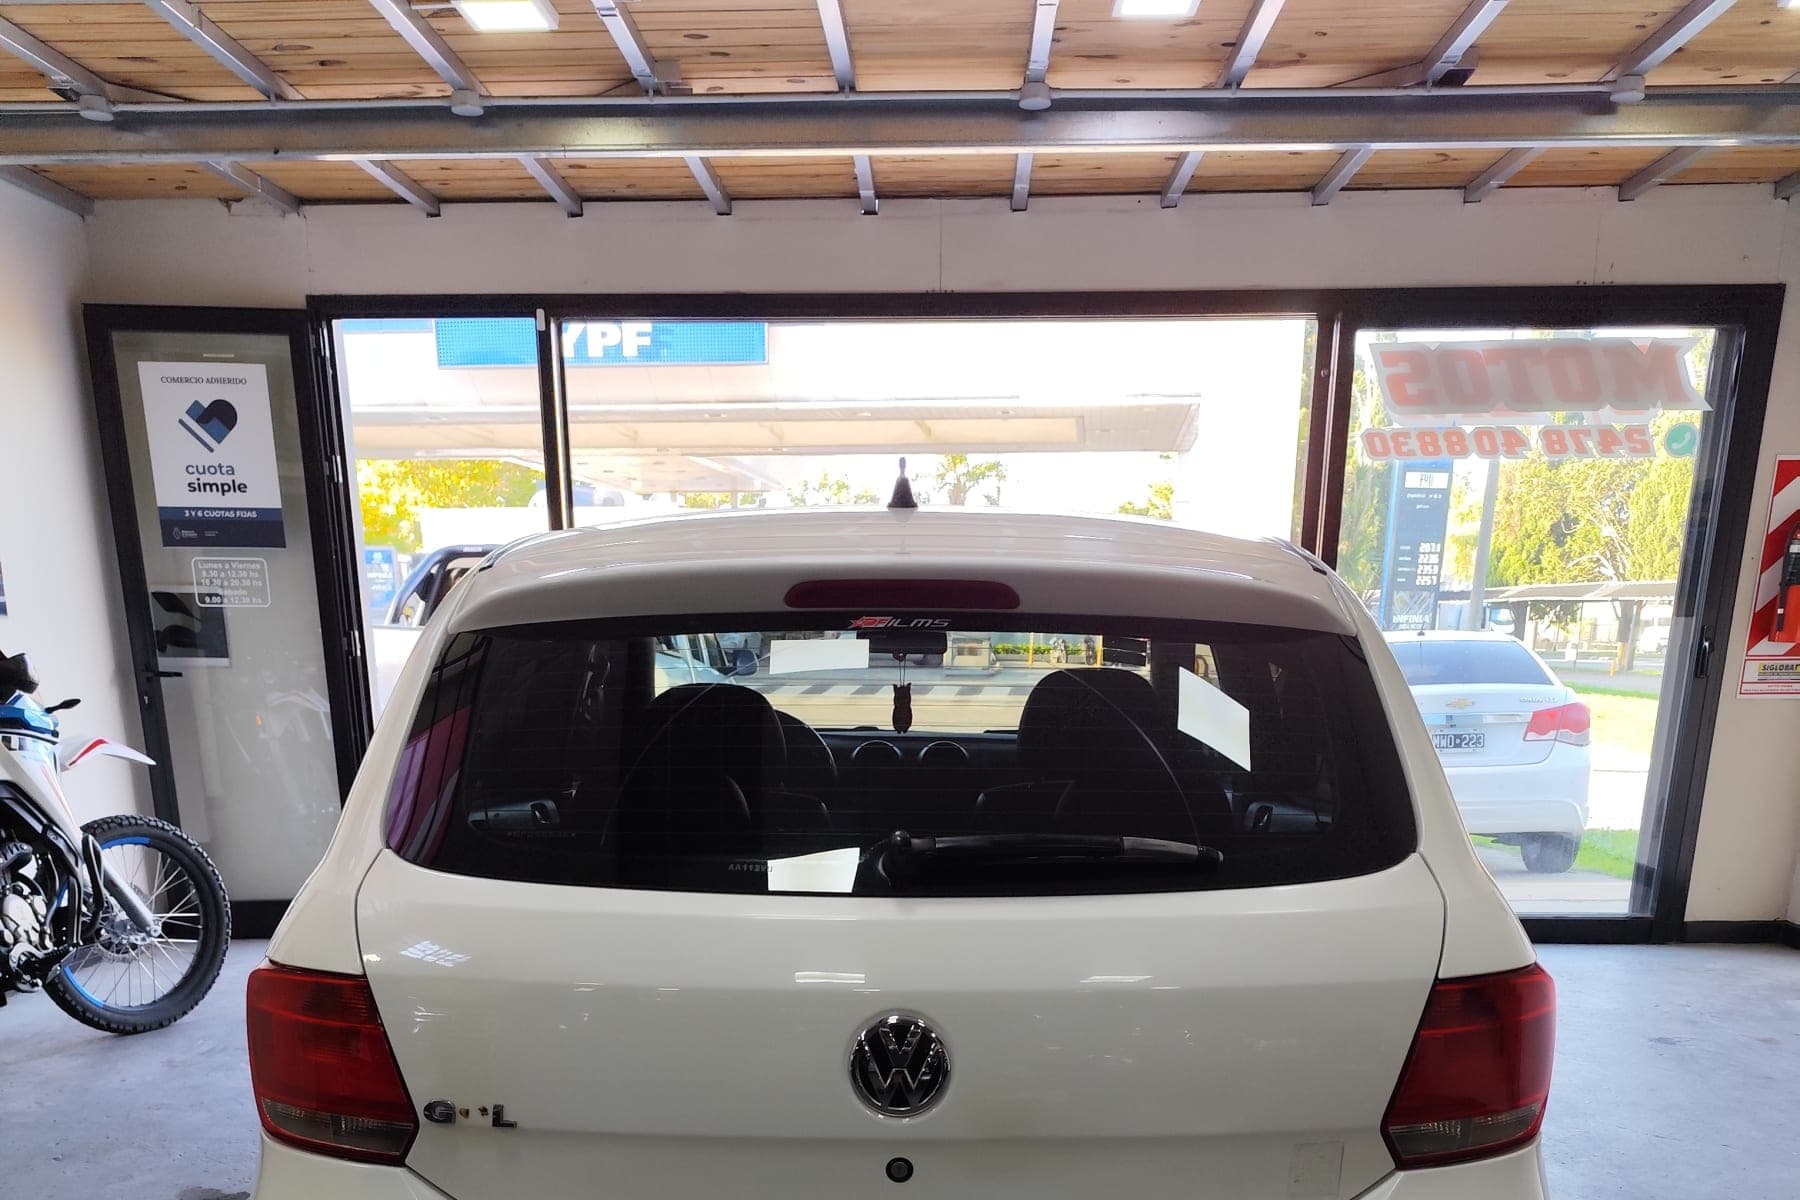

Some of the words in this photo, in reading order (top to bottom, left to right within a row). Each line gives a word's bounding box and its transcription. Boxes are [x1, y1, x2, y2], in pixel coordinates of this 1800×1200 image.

[562, 322, 652, 358] YPF
[160, 376, 204, 385] COMERCIO
[205, 377, 247, 385] ADHERIDO
[185, 463, 235, 476] cuota
[187, 478, 248, 496] simple
[203, 510, 235, 518] CUOTAS
[198, 561, 223, 569] Lunes
[230, 561, 261, 569] Viernes
[1461, 734, 1484, 748] 223
[423, 1100, 518, 1128] GL
